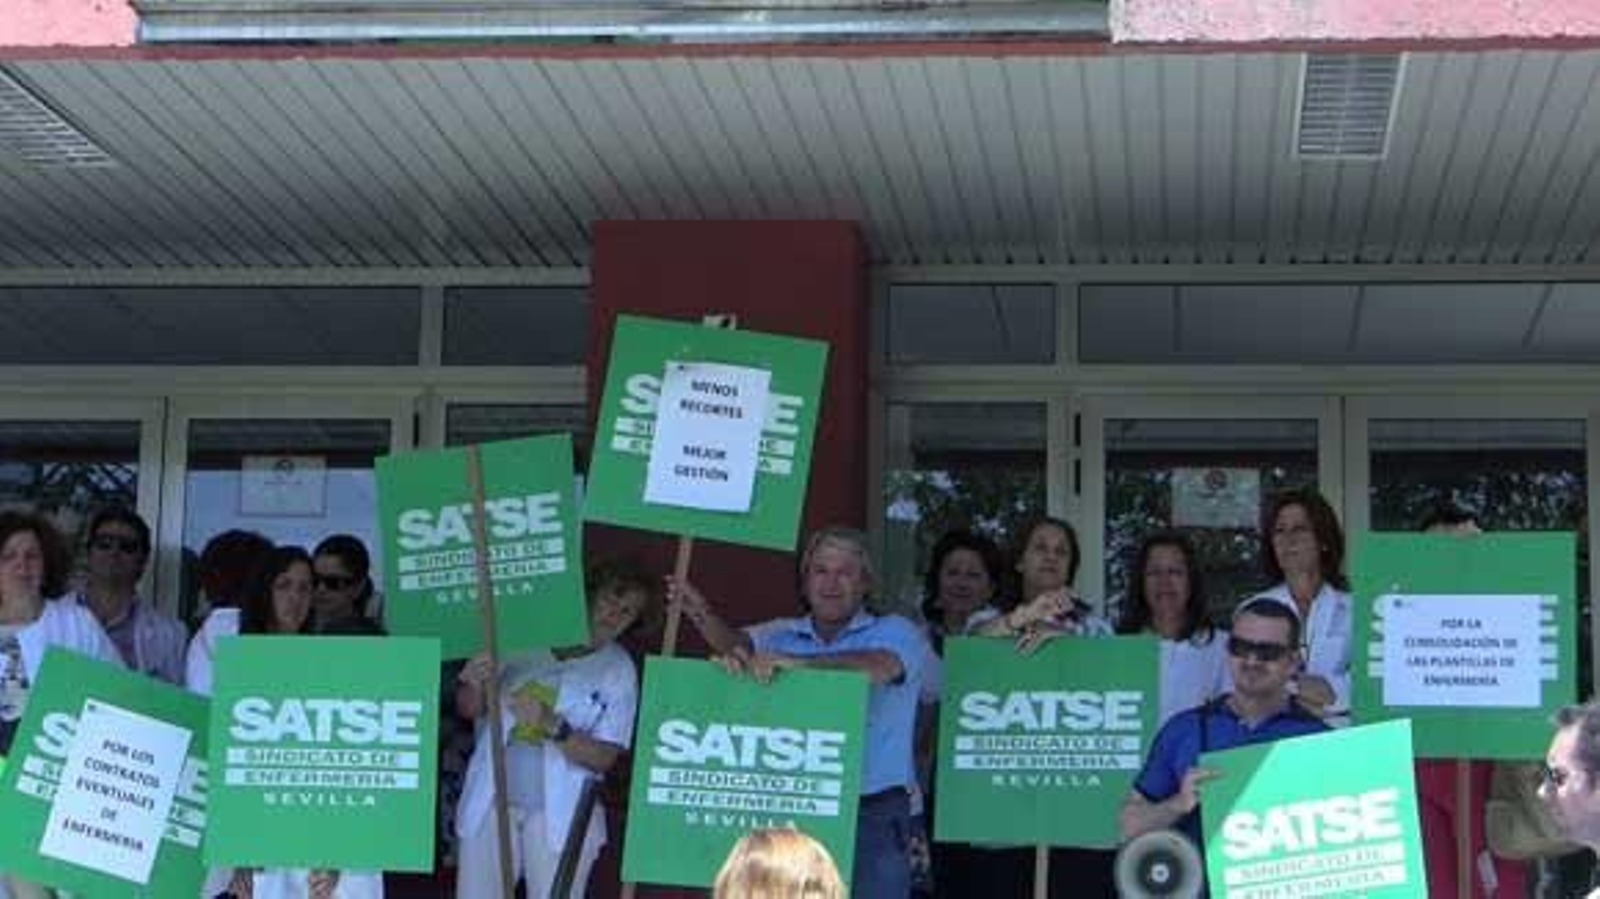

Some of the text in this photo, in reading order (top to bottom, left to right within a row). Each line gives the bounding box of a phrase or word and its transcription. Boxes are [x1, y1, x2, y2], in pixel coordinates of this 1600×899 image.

[691, 379, 739, 398] MENOS
[680, 398, 743, 419] RECORTES
[683, 444, 727, 461] MEJOR
[436, 582, 534, 603] SEVLLA
[1441, 618, 1482, 629] POR LA
[1407, 657, 1427, 667] LAS
[229, 696, 422, 745] SATSE
[958, 690, 1144, 731] SATSE
[103, 739, 155, 766] POR LOS
[655, 718, 846, 773] SATSE
[974, 736, 1122, 750] SINDICATO DE
[245, 749, 398, 766] SINDICATO DE
[84, 756, 160, 789] CONTRATOS
[668, 770, 817, 793] SINDICATO DE
[992, 774, 1102, 787] SEVILLA
[76, 775, 155, 811] EVENTUALES
[263, 791, 377, 806] SEVILLA
[100, 807, 118, 821] DE
[1222, 786, 1403, 861] SATSE
[1240, 848, 1386, 881] SINDICATO DE
